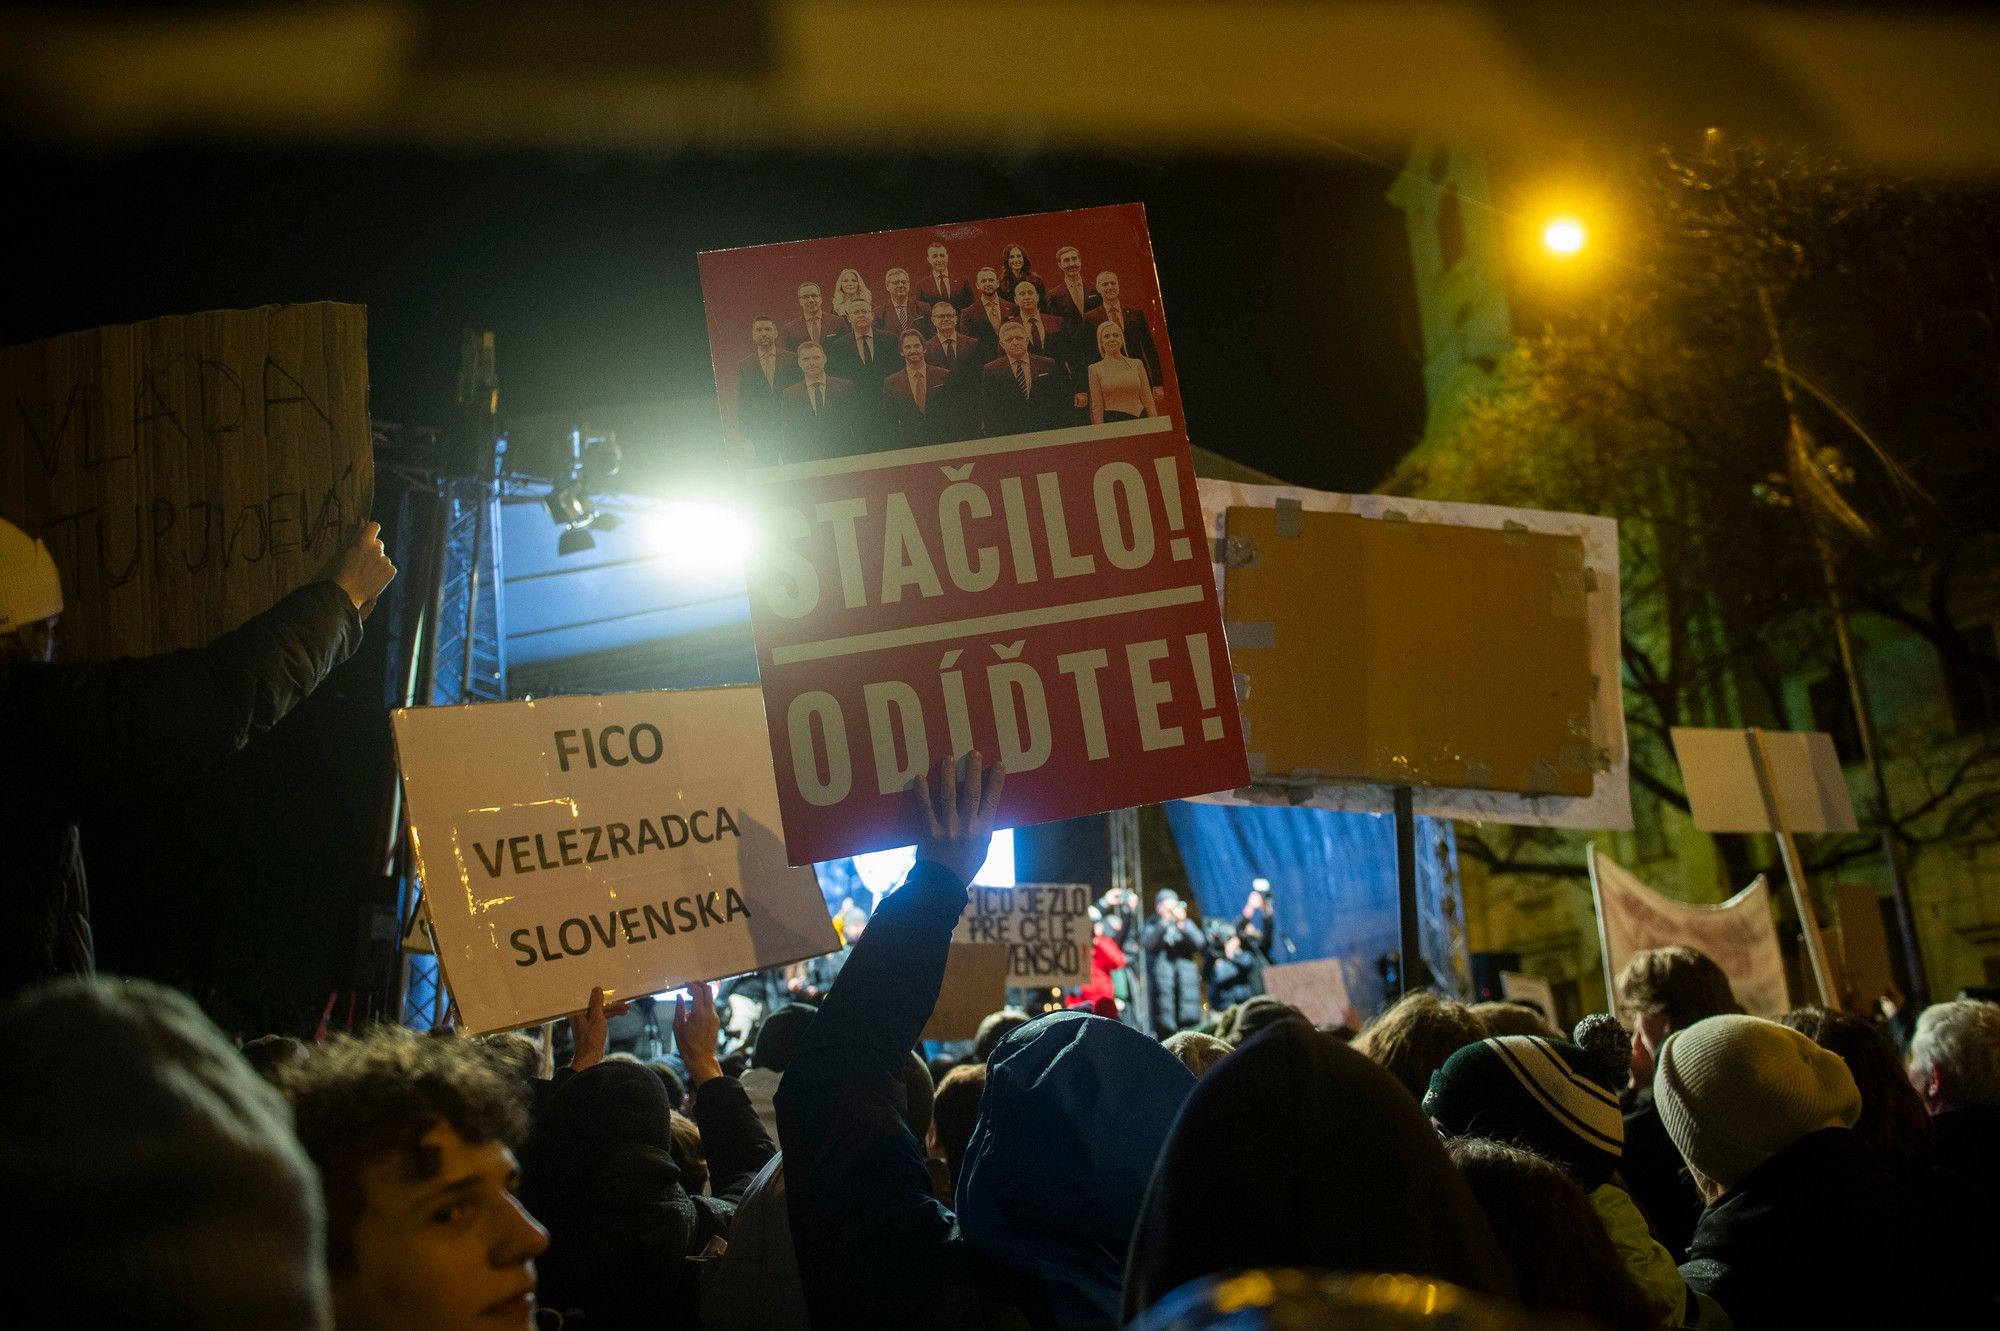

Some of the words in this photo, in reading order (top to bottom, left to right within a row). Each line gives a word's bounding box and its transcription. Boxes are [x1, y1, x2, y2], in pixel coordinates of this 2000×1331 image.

[763, 457, 1193, 620] STAČILO!
[554, 723, 663, 772] FICO
[787, 633, 1225, 806] ODÍĎTE!
[473, 807, 741, 878] VELEZRADCA
[509, 887, 752, 967] SLOVENSKA
[968, 916, 1010, 942] PRE
